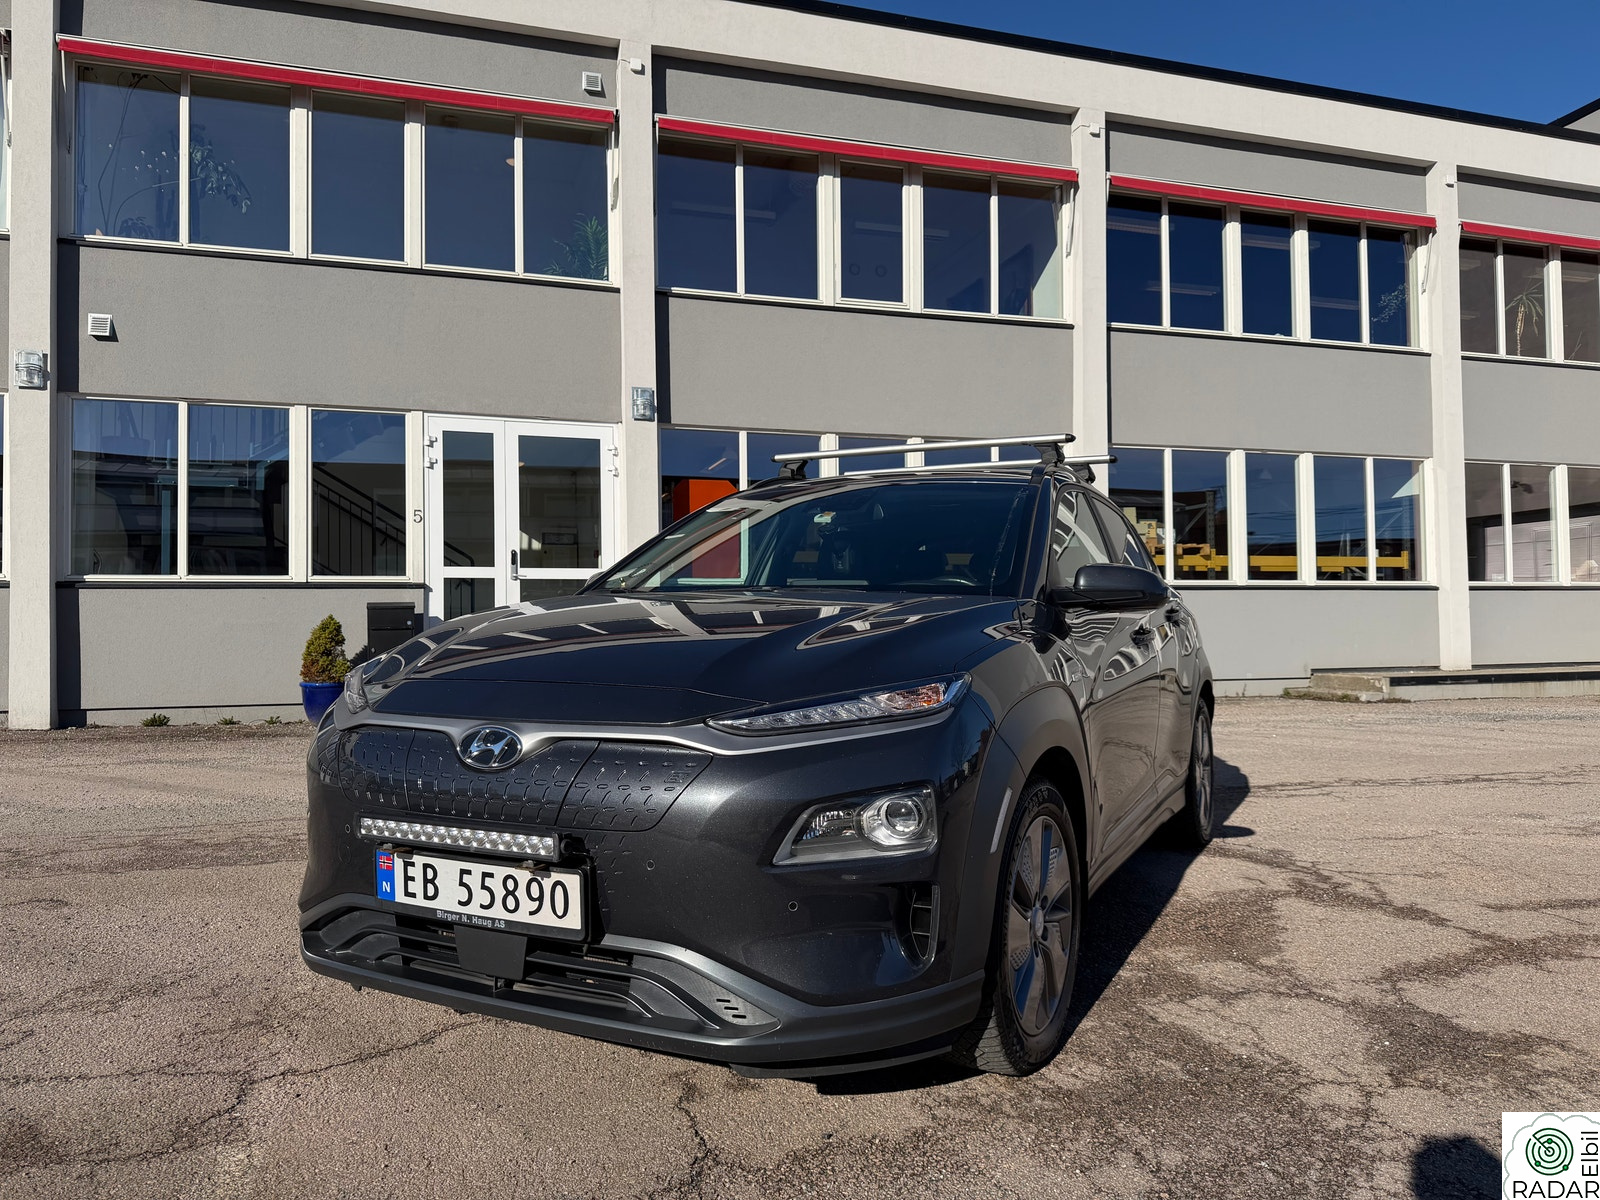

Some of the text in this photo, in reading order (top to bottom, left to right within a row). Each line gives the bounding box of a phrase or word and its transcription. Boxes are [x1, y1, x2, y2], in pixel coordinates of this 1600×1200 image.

[413, 509, 423, 523] 5
[382, 880, 391, 893] N
[402, 859, 570, 920] EB 55890
[436, 910, 506, 929] Birger N. Haug AS
